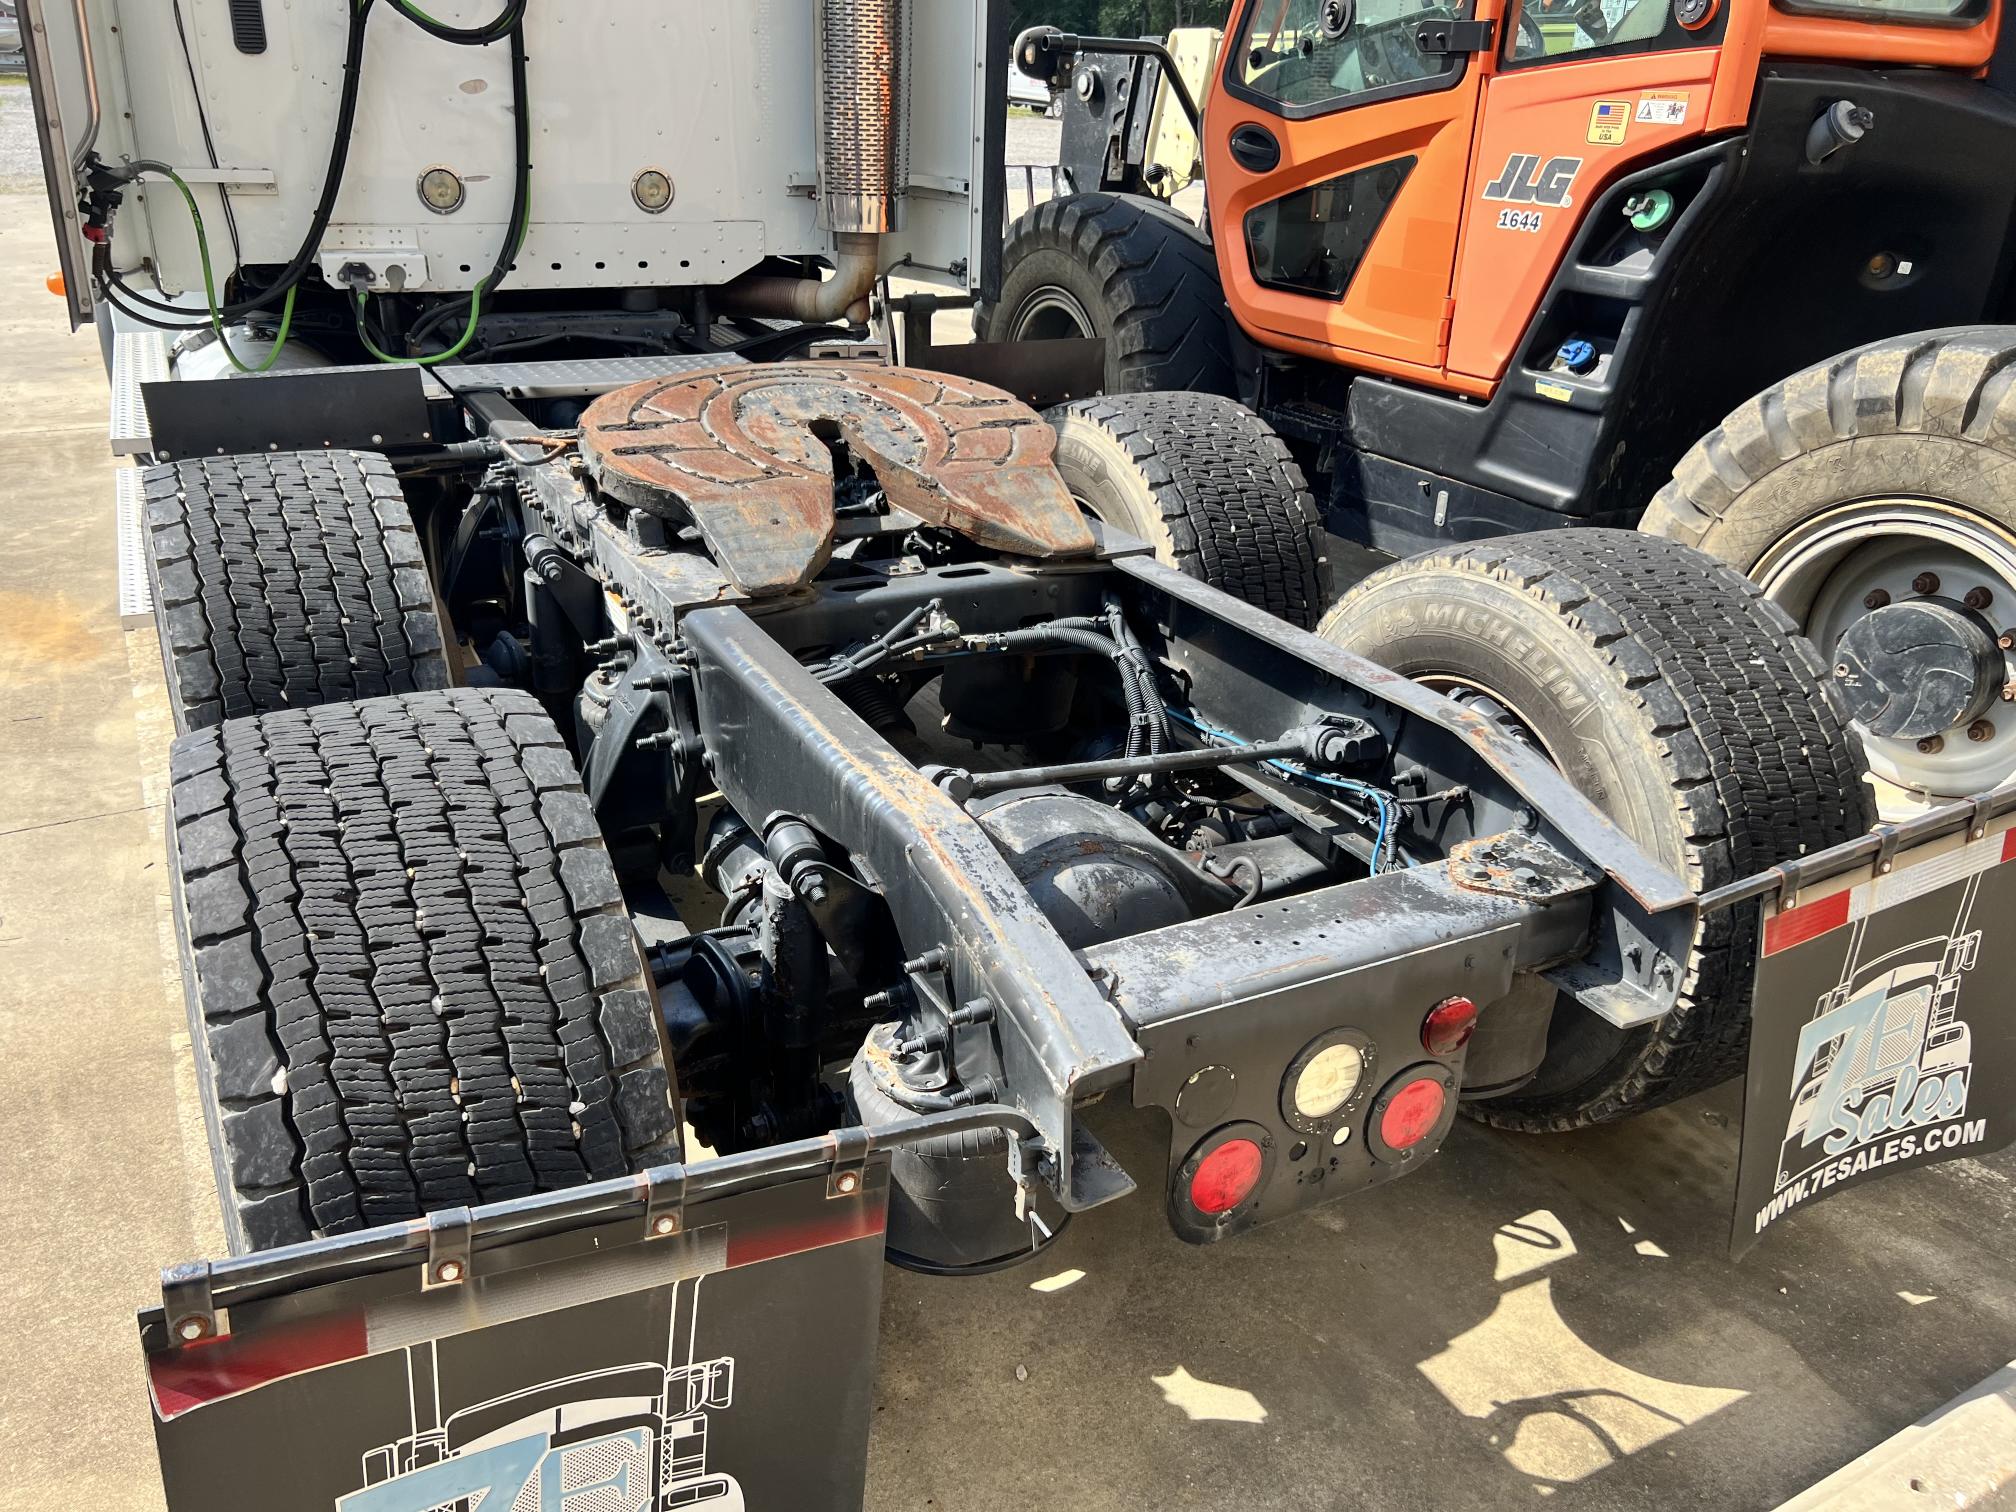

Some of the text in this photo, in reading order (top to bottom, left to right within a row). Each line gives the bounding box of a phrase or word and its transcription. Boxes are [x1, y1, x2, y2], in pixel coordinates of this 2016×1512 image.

[1482, 153, 1583, 207] JLG
[1598, 133, 1612, 141] USA
[1498, 210, 1541, 231] 1644
[1423, 602, 1588, 710] MICHELIN
[1790, 984, 1933, 1149] 7E
[1823, 1064, 1967, 1155] Sales
[1755, 1119, 1987, 1234] WWW.7ESALES.COM
